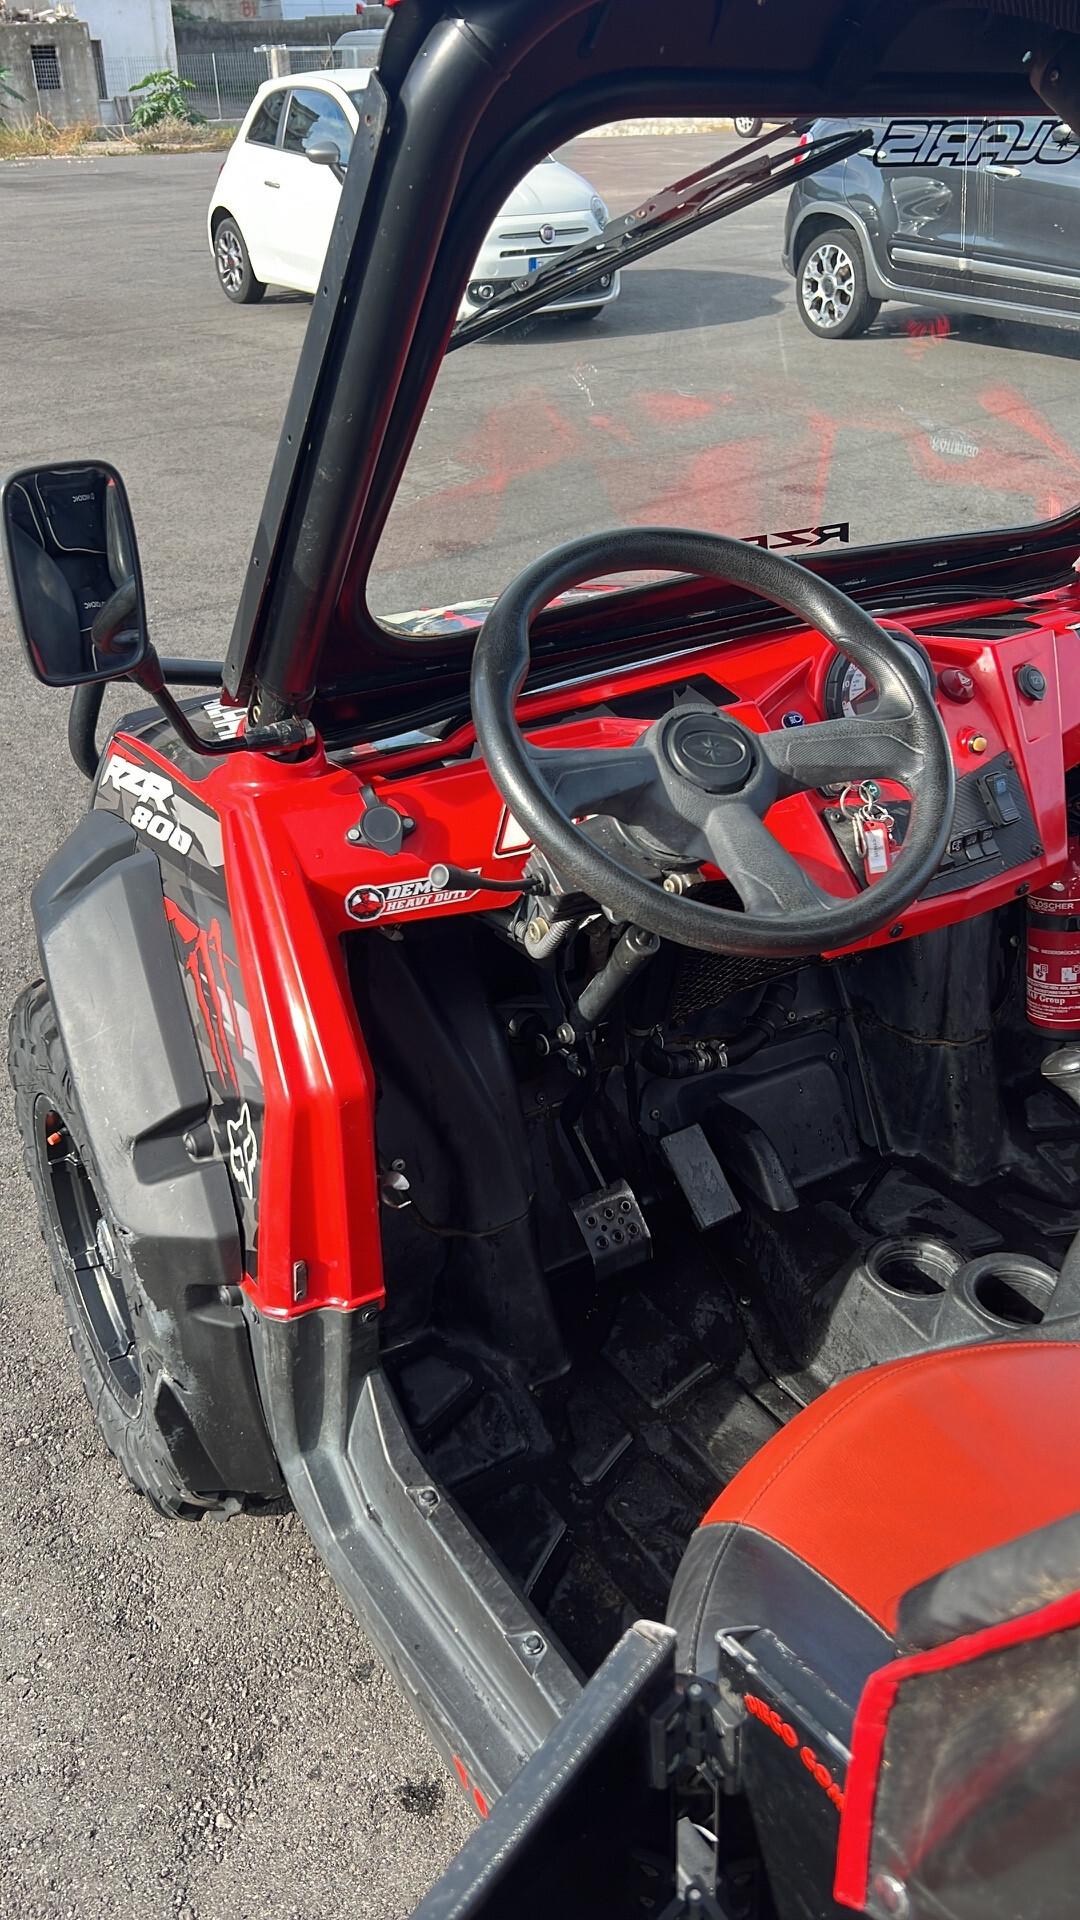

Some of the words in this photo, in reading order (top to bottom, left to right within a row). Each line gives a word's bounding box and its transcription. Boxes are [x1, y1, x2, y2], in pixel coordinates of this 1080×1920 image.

[101, 754, 174, 815] RZR
[130, 805, 193, 855] 800
[386, 894, 433, 911] HEAVY
[1039, 996, 1066, 1006] Group
